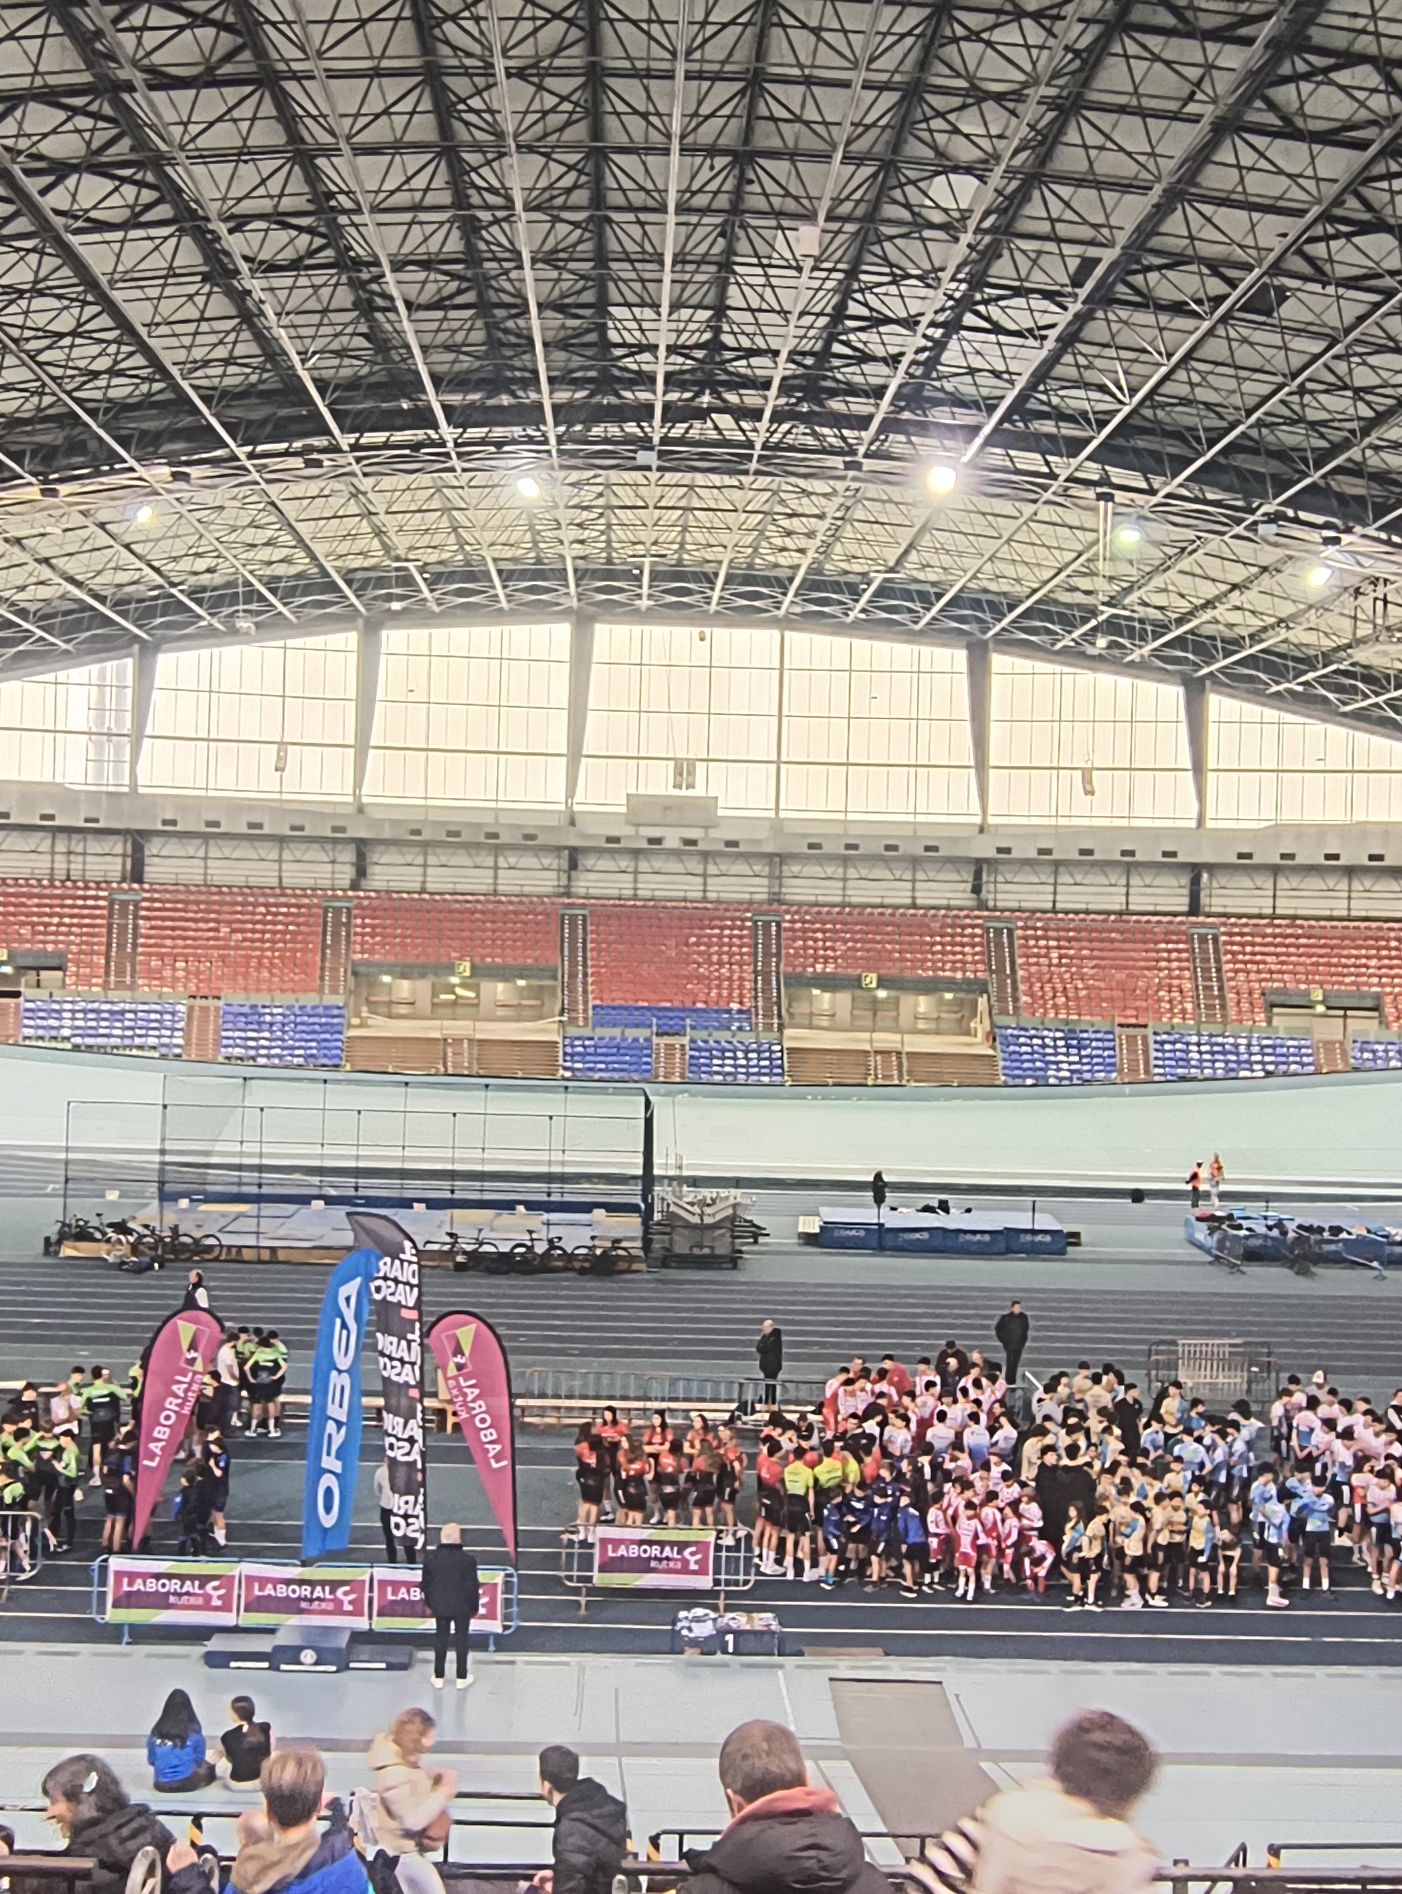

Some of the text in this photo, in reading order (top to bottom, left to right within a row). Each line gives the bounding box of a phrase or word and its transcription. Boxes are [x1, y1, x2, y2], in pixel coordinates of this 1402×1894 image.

[317, 1276, 362, 1528] ORBEA
[142, 1371, 193, 1468] LABORAL
[607, 1544, 683, 1559] LABORAL
[122, 1577, 205, 1594] LABORAL
[253, 1582, 335, 1599] LABORAL
[724, 1634, 734, 1653] 1
